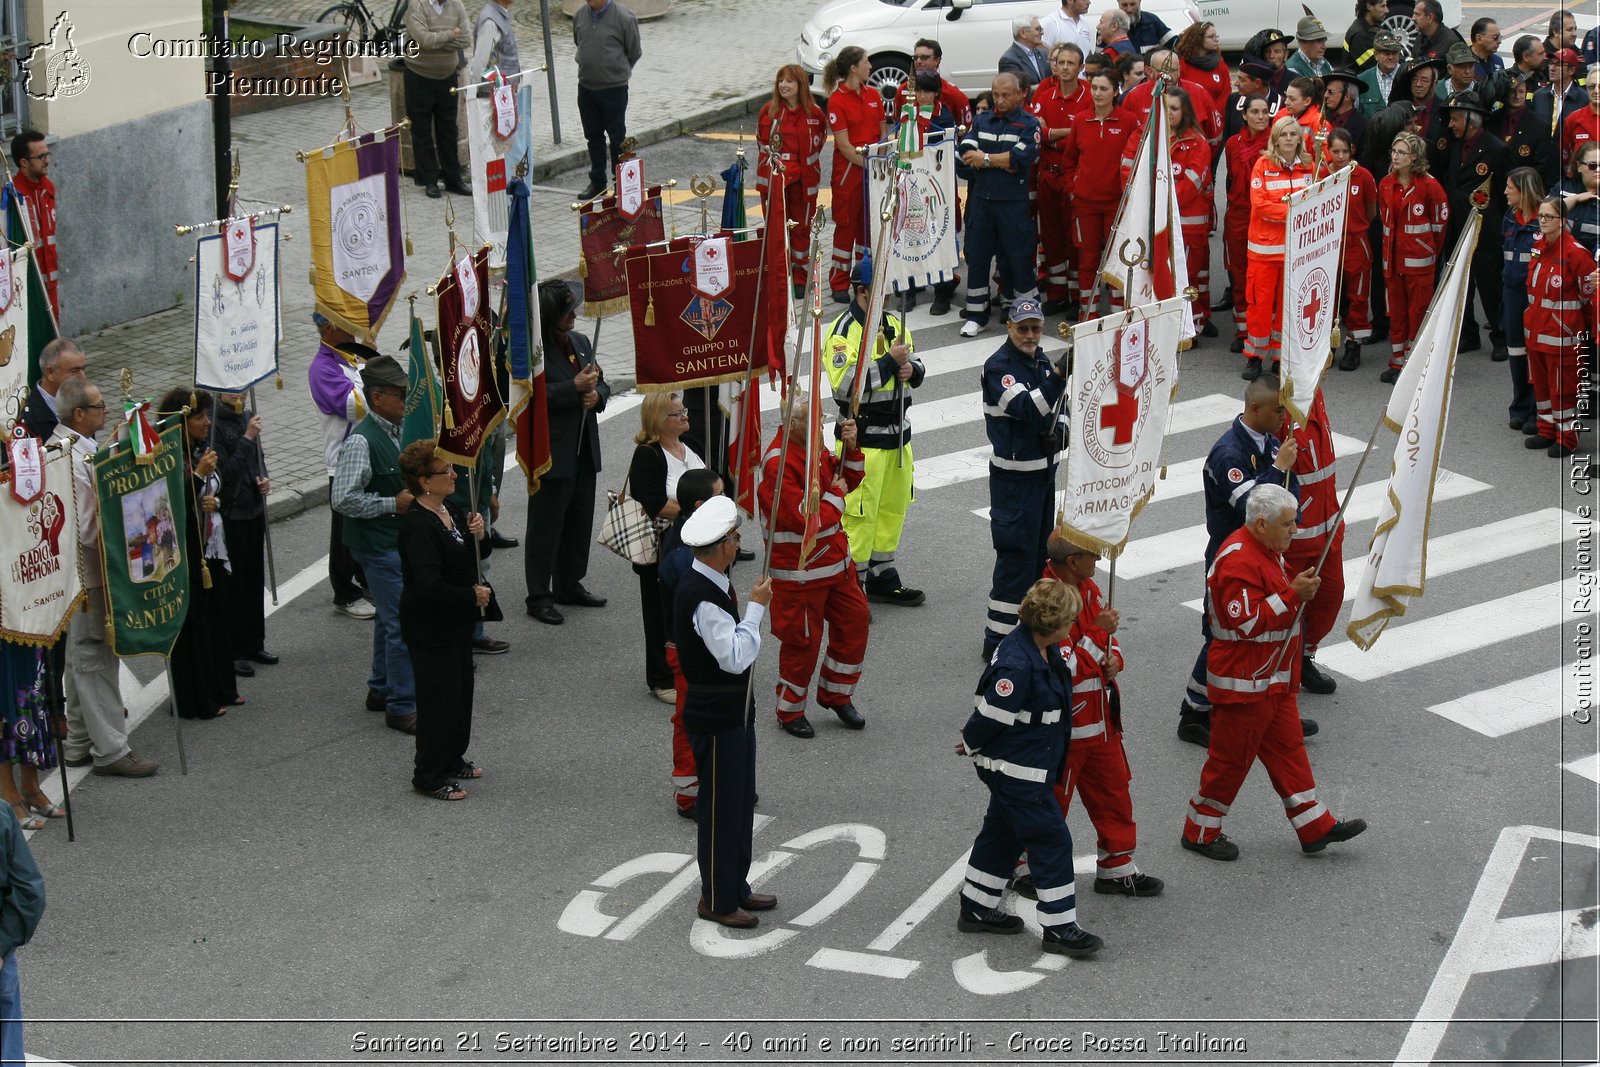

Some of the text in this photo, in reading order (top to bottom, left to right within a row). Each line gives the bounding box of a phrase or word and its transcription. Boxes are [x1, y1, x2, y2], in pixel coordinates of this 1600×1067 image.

[1202, 7, 1230, 17] SANTENA
[1292, 206, 1318, 232] CROCE
[1298, 218, 1335, 250] ITALIANA
[342, 264, 380, 281] SANTENA
[638, 277, 684, 290] ASSOCIAZIONE
[682, 338, 739, 356] GRUPPO DI
[675, 352, 749, 375] SANTENA
[1077, 359, 1105, 412] CROCE
[1084, 378, 1110, 465] CONVENZIONE DI
[108, 454, 176, 498] PRO LOCO
[1141, 461, 1153, 473] DI
[20, 557, 61, 585] MEMORIA
[33, 589, 65, 608] SANTENA
[125, 592, 185, 629] SANTEN
